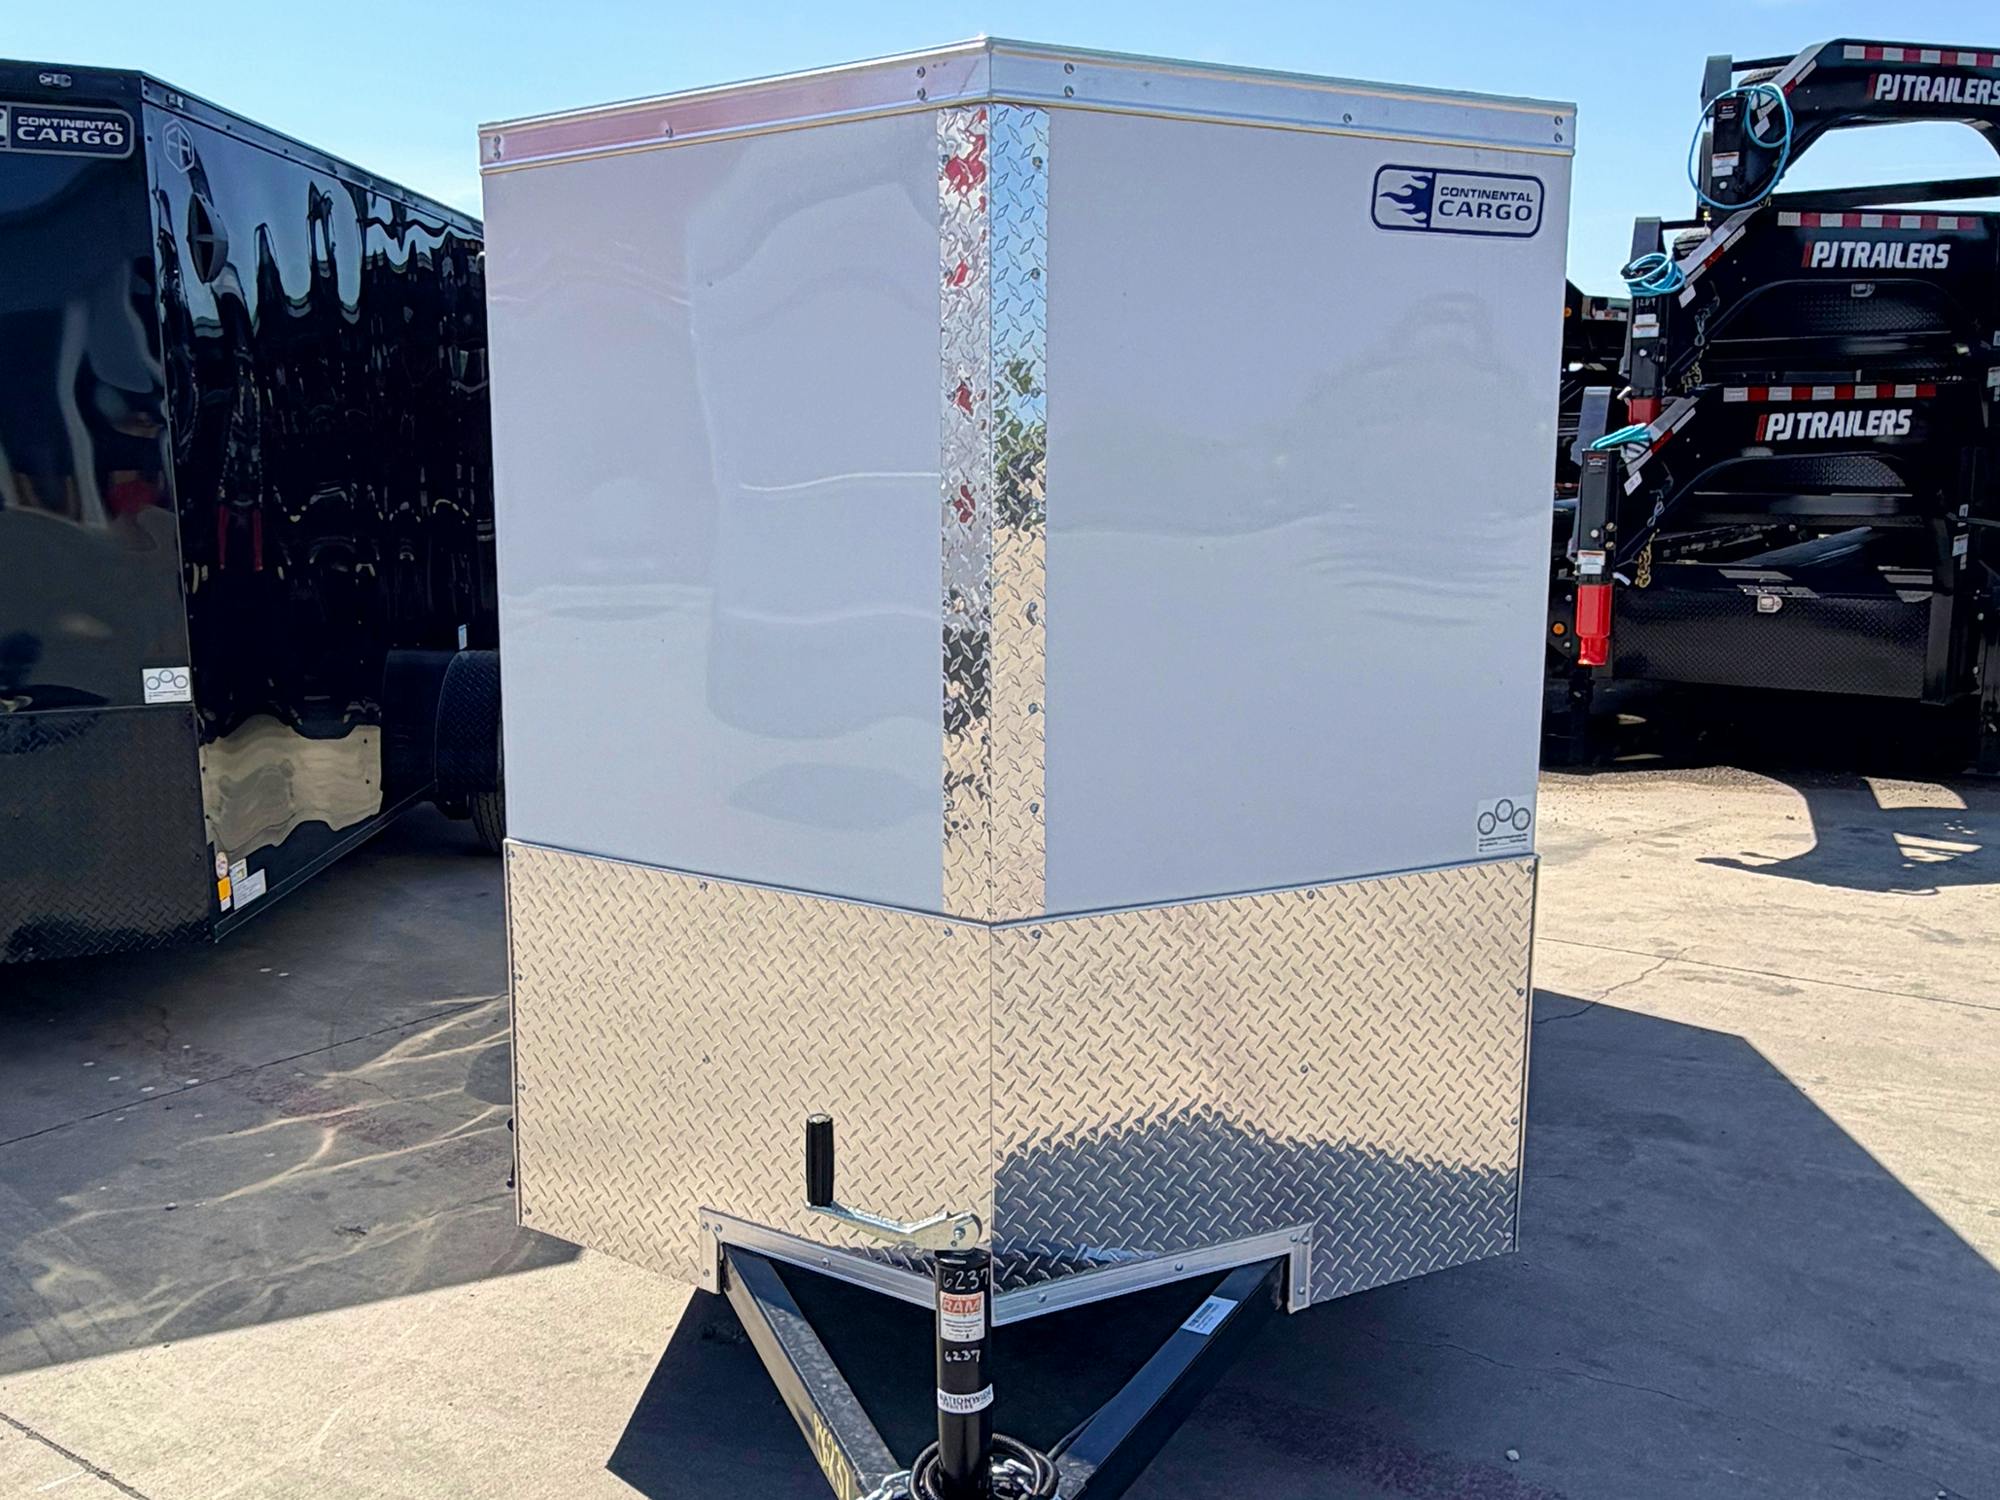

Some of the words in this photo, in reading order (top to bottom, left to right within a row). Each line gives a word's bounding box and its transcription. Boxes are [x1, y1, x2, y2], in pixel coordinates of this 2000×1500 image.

[1874, 73, 1901, 101] PJ
[1902, 74, 2000, 105] TRAILERS
[17, 115, 124, 132] CONTINENTAL
[16, 126, 124, 146] CARGO
[1440, 186, 1534, 203] CONTINENTAL
[1438, 200, 1533, 221] CARGO
[1811, 241, 1839, 268] PJ
[1840, 242, 1951, 269] TRAILERS
[1764, 413, 1795, 441] PJ
[1796, 409, 1913, 440] TRAILERS
[942, 1267, 989, 1290] 6237
[942, 1298, 981, 1314] RAM
[945, 1349, 981, 1363] 6237
